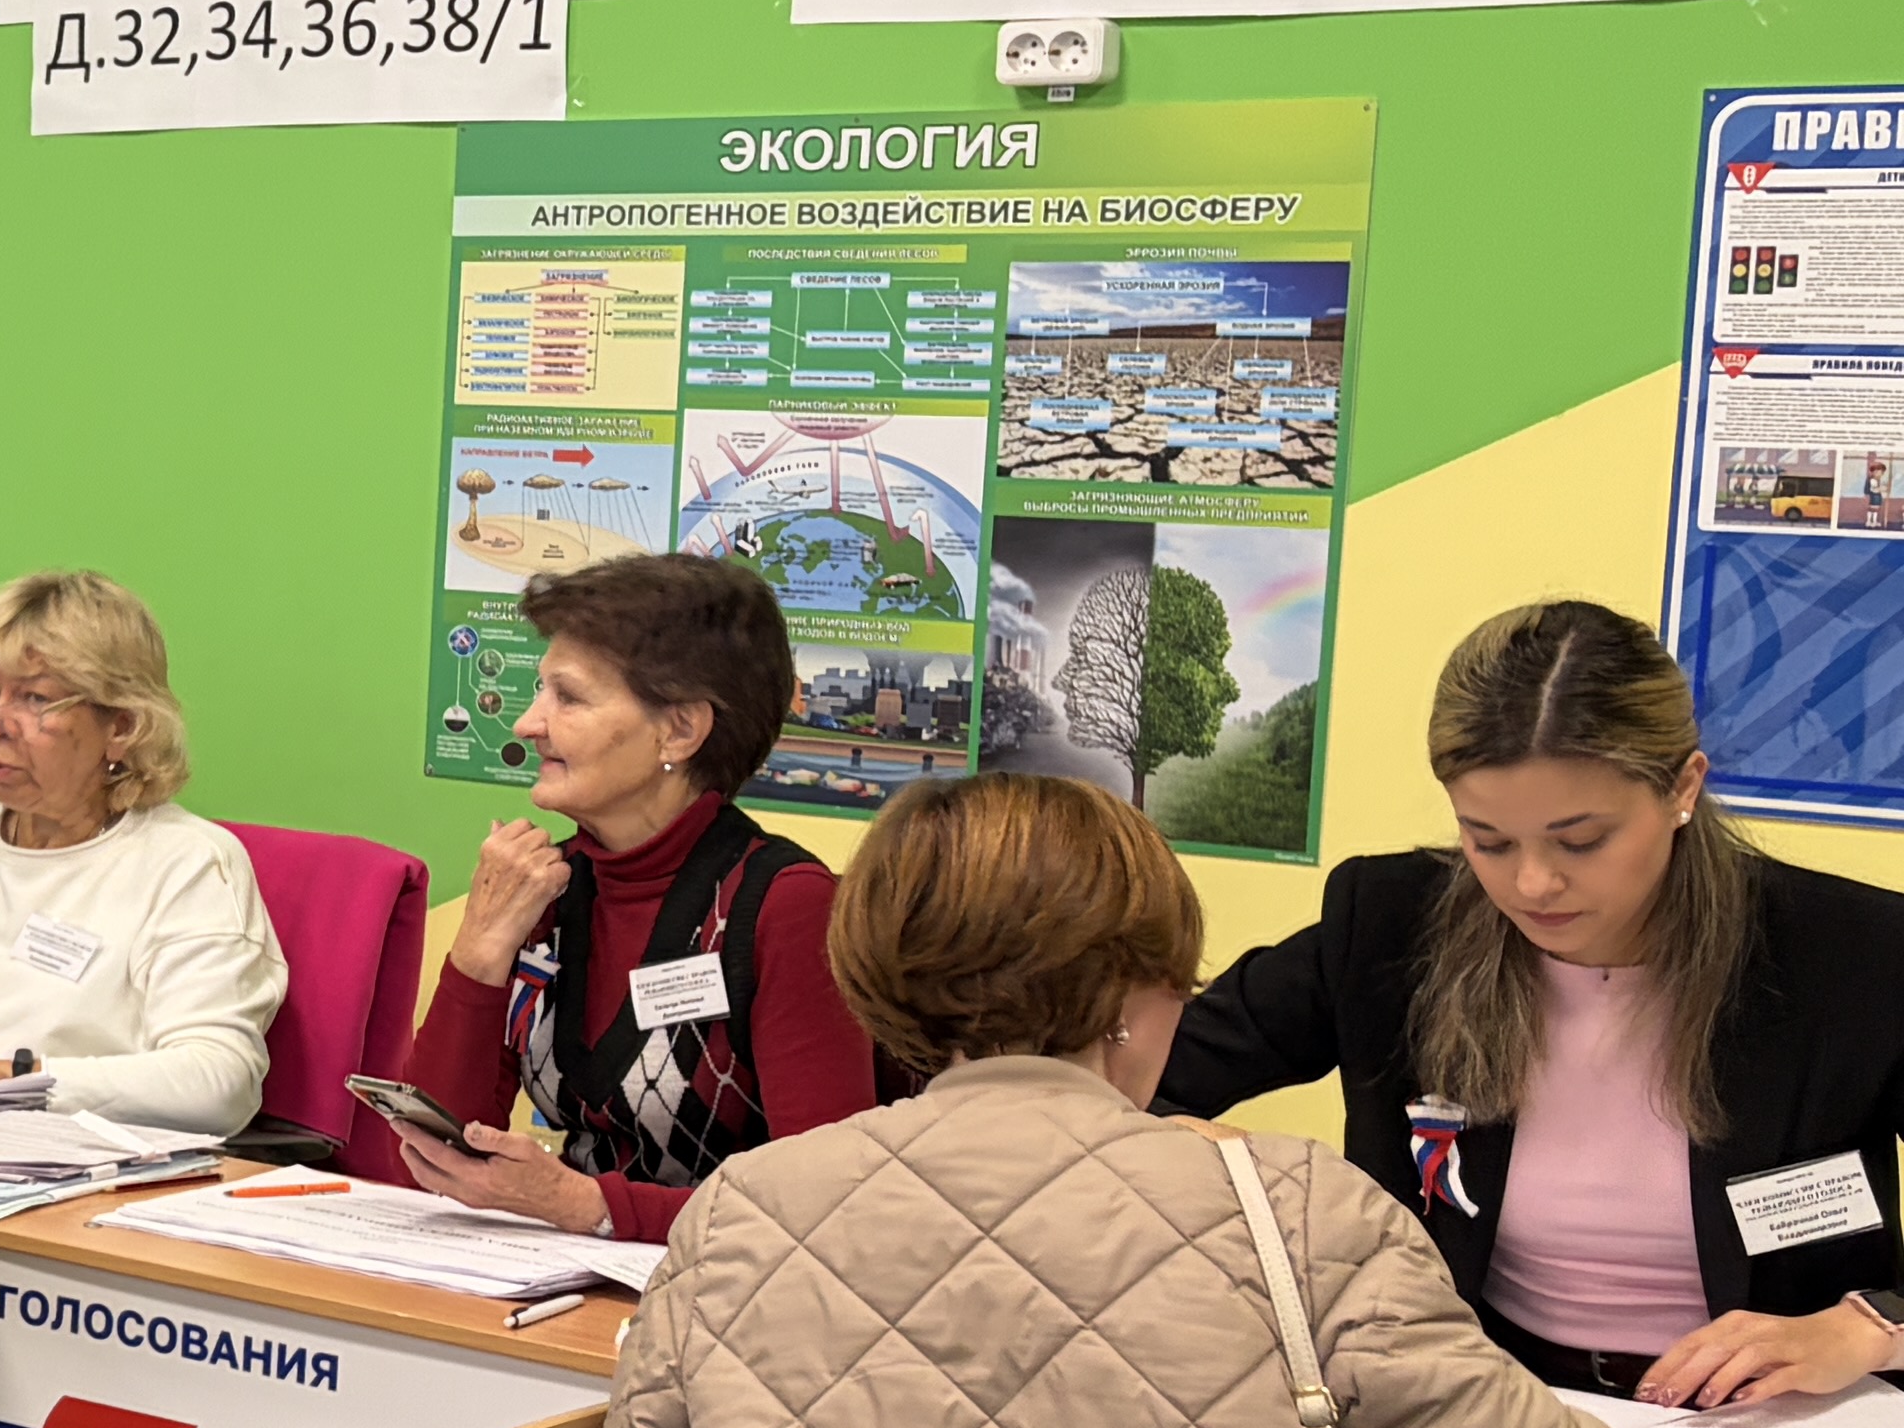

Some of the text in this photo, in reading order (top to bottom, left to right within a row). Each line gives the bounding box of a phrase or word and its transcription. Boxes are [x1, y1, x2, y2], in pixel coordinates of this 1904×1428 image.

[719, 123, 1039, 172] ЭКОЛОГИЯ
[531, 195, 1299, 229] АНТРОПОГЕННОЕ ВОЗДЕЙСТВИЕ НА БИОСФЕРУ
[748, 249, 830, 259] ПОСЛЕДСТВИЯ
[1866, 359, 1904, 372] ПОВЕД
